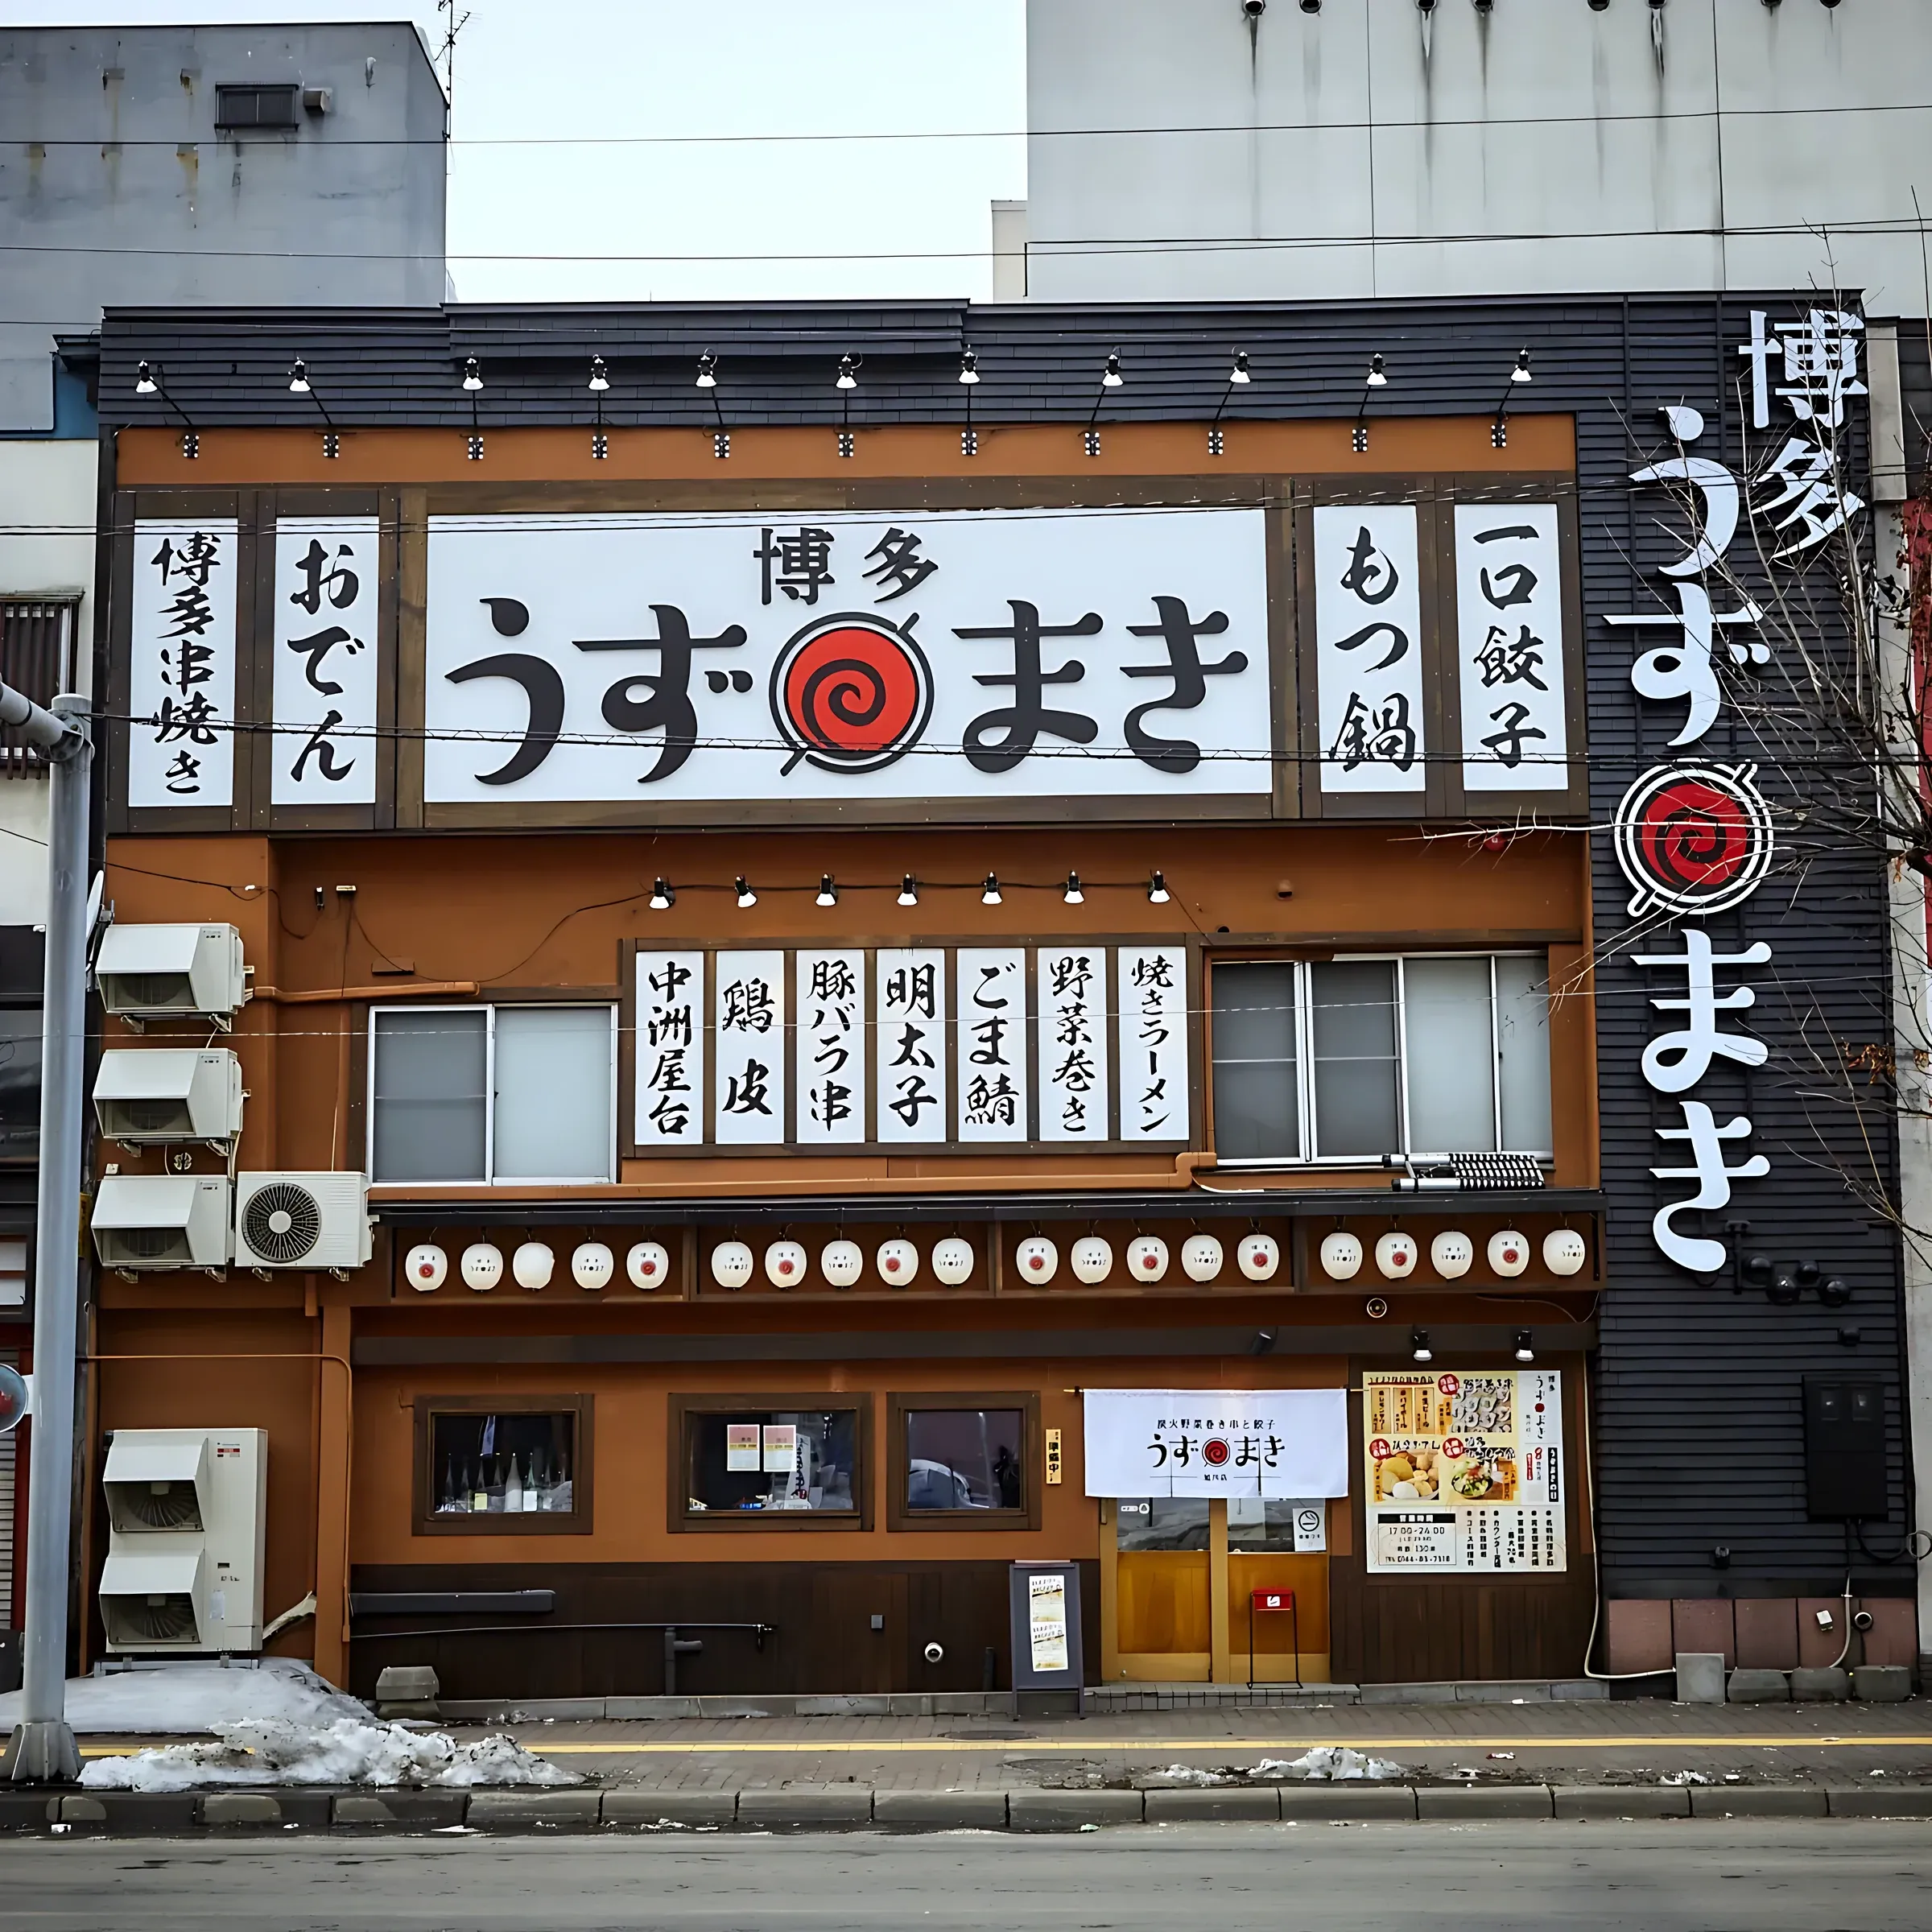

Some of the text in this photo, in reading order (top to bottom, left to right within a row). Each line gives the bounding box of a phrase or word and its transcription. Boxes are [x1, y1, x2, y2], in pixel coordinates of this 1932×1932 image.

[1737, 309, 1868, 561] 博多
[753, 526, 939, 605] 博多
[1330, 525, 1417, 773] もつ鍋
[1472, 524, 1549, 769] 一口餃子
[150, 530, 221, 794] 博多串焼き
[287, 539, 365, 783] おでん
[646, 960, 691, 1134] 中洲屋台
[721, 977, 775, 1115] 鶏皮
[806, 959, 855, 1131] 豚バラ串
[886, 963, 937, 1128] 明太子
[964, 962, 1019, 1126] ごま鯖
[1050, 956, 1096, 1133] 野菜巻き
[1131, 954, 1174, 1133] 焼きラーメン
